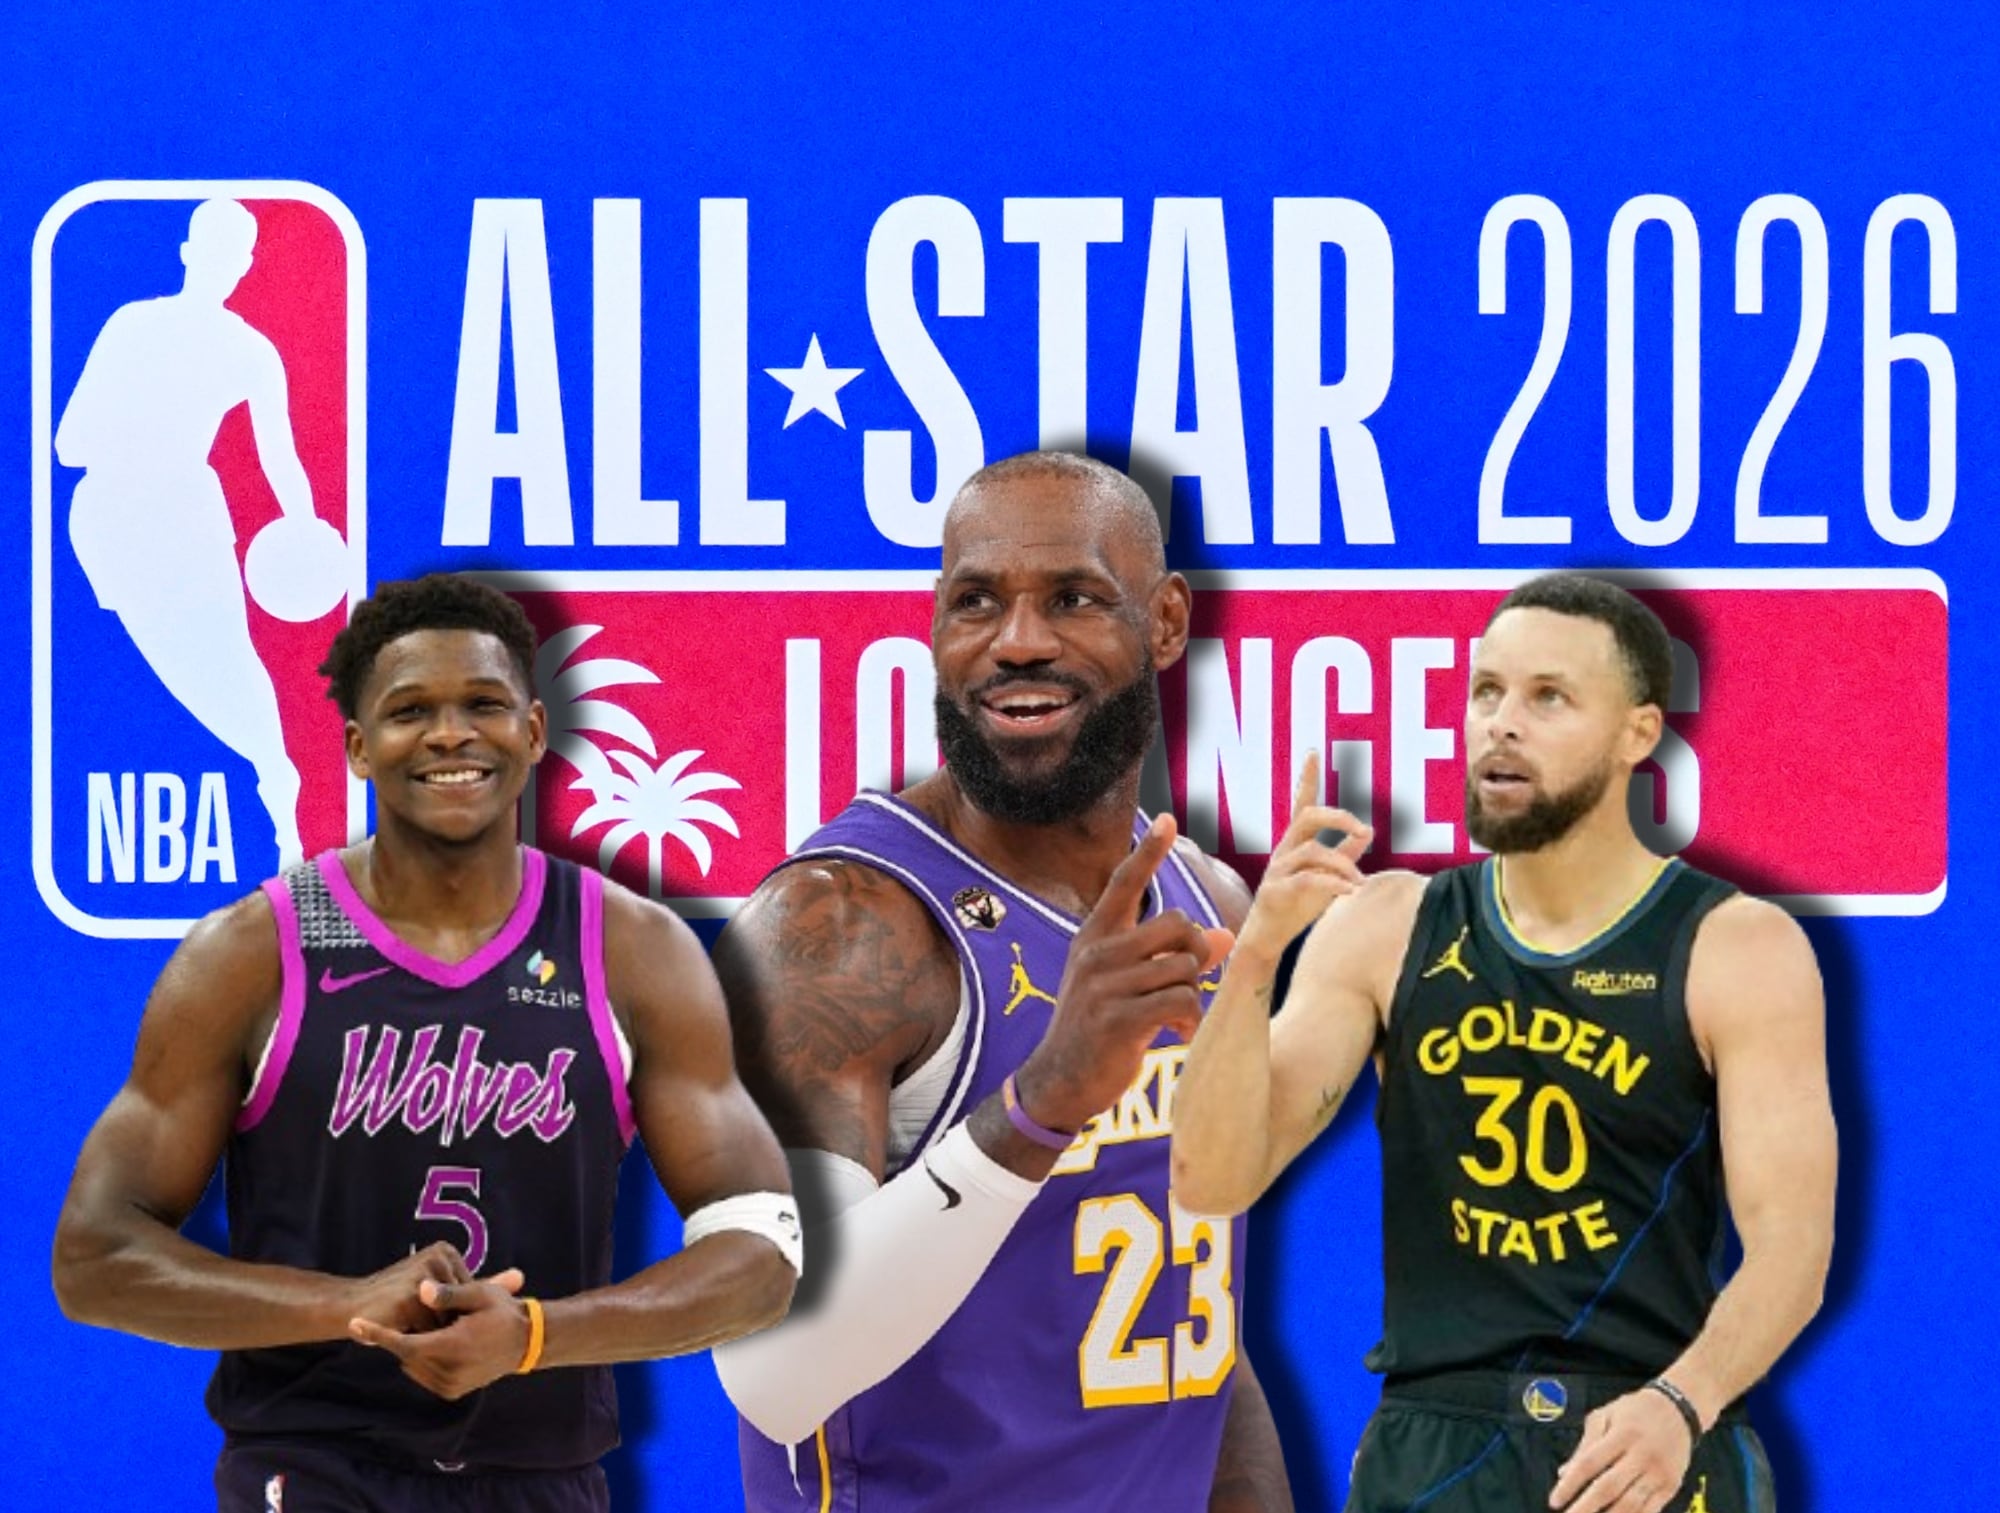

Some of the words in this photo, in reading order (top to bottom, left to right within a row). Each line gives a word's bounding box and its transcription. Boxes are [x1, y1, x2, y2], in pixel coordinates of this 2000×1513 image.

[441, 197, 786, 546] ALL
[863, 195, 1396, 547] STAR
[1477, 193, 1958, 547] 2026
[785, 636, 939, 855] LO
[87, 771, 237, 883] NBA
[507, 986, 582, 1010] sezzle
[1572, 969, 1657, 996] Rakuten
[327, 1023, 578, 1147] Wolves
[1418, 1002, 1650, 1095] GOLDEN
[1458, 1076, 1588, 1191] 30
[414, 1165, 489, 1277] 5
[1451, 1199, 1619, 1265] STATE
[1073, 1184, 1236, 1409] 23
